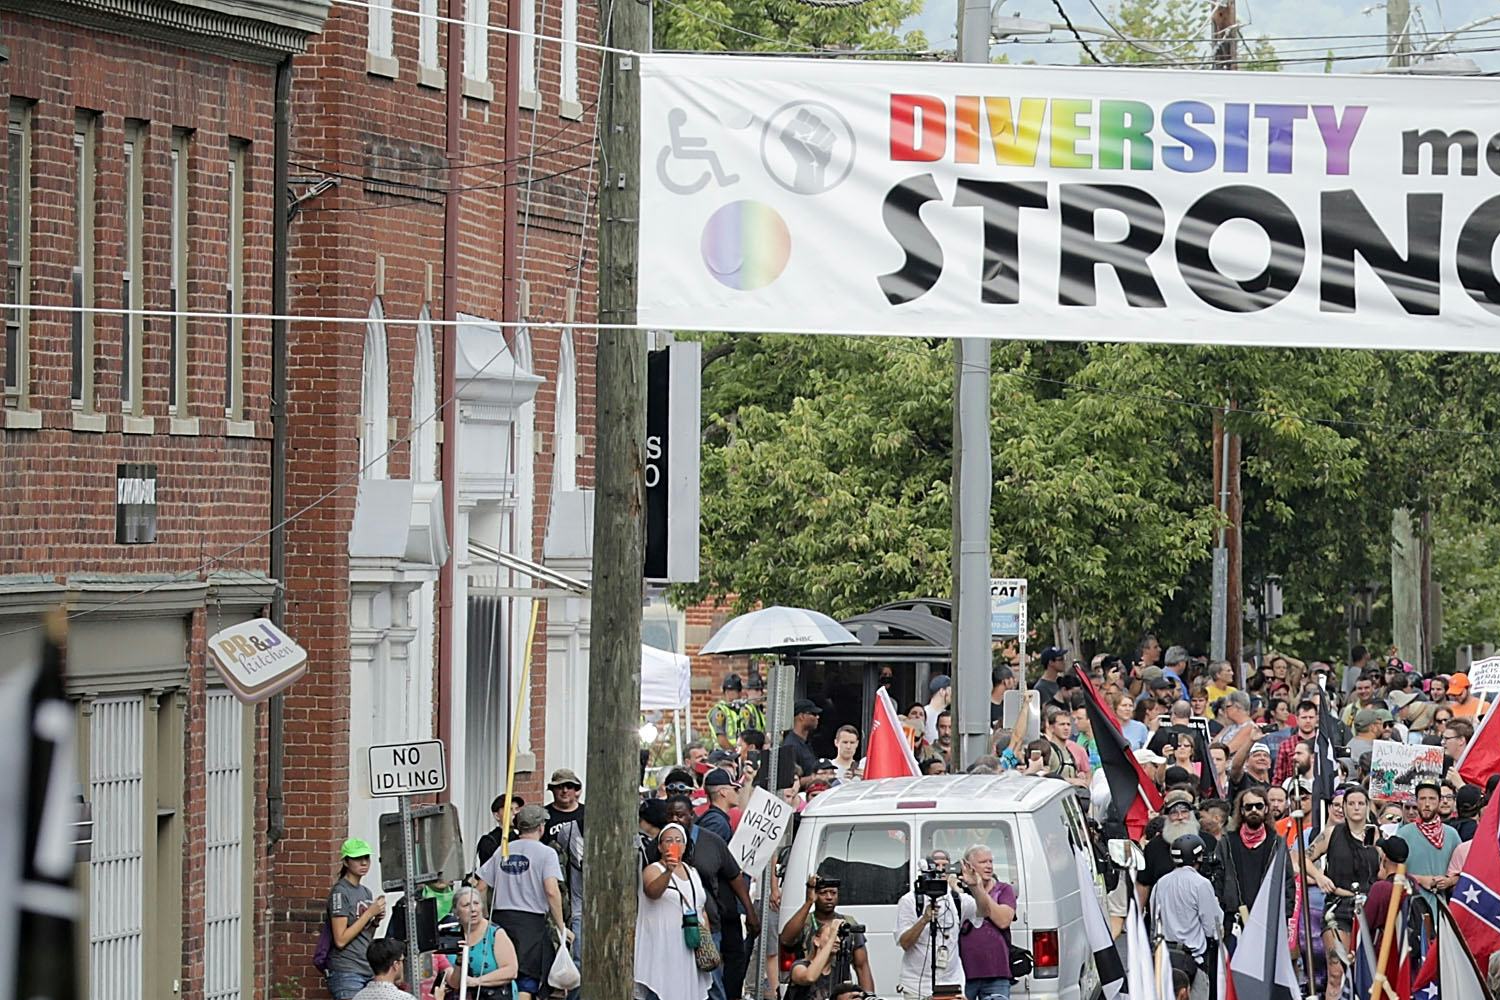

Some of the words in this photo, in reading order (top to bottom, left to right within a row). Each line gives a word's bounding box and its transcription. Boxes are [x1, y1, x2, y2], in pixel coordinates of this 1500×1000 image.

[889, 92, 1369, 176] DIVERSITY
[991, 586, 1018, 598] CAT
[217, 623, 282, 664] PB&J
[238, 645, 294, 675] kitchen
[393, 747, 420, 766] NO
[376, 769, 439, 789] IDLING
[763, 799, 782, 819] NO
[744, 810, 781, 841] NAZIS
[752, 834, 765, 848] IN
[741, 844, 756, 866] VA
